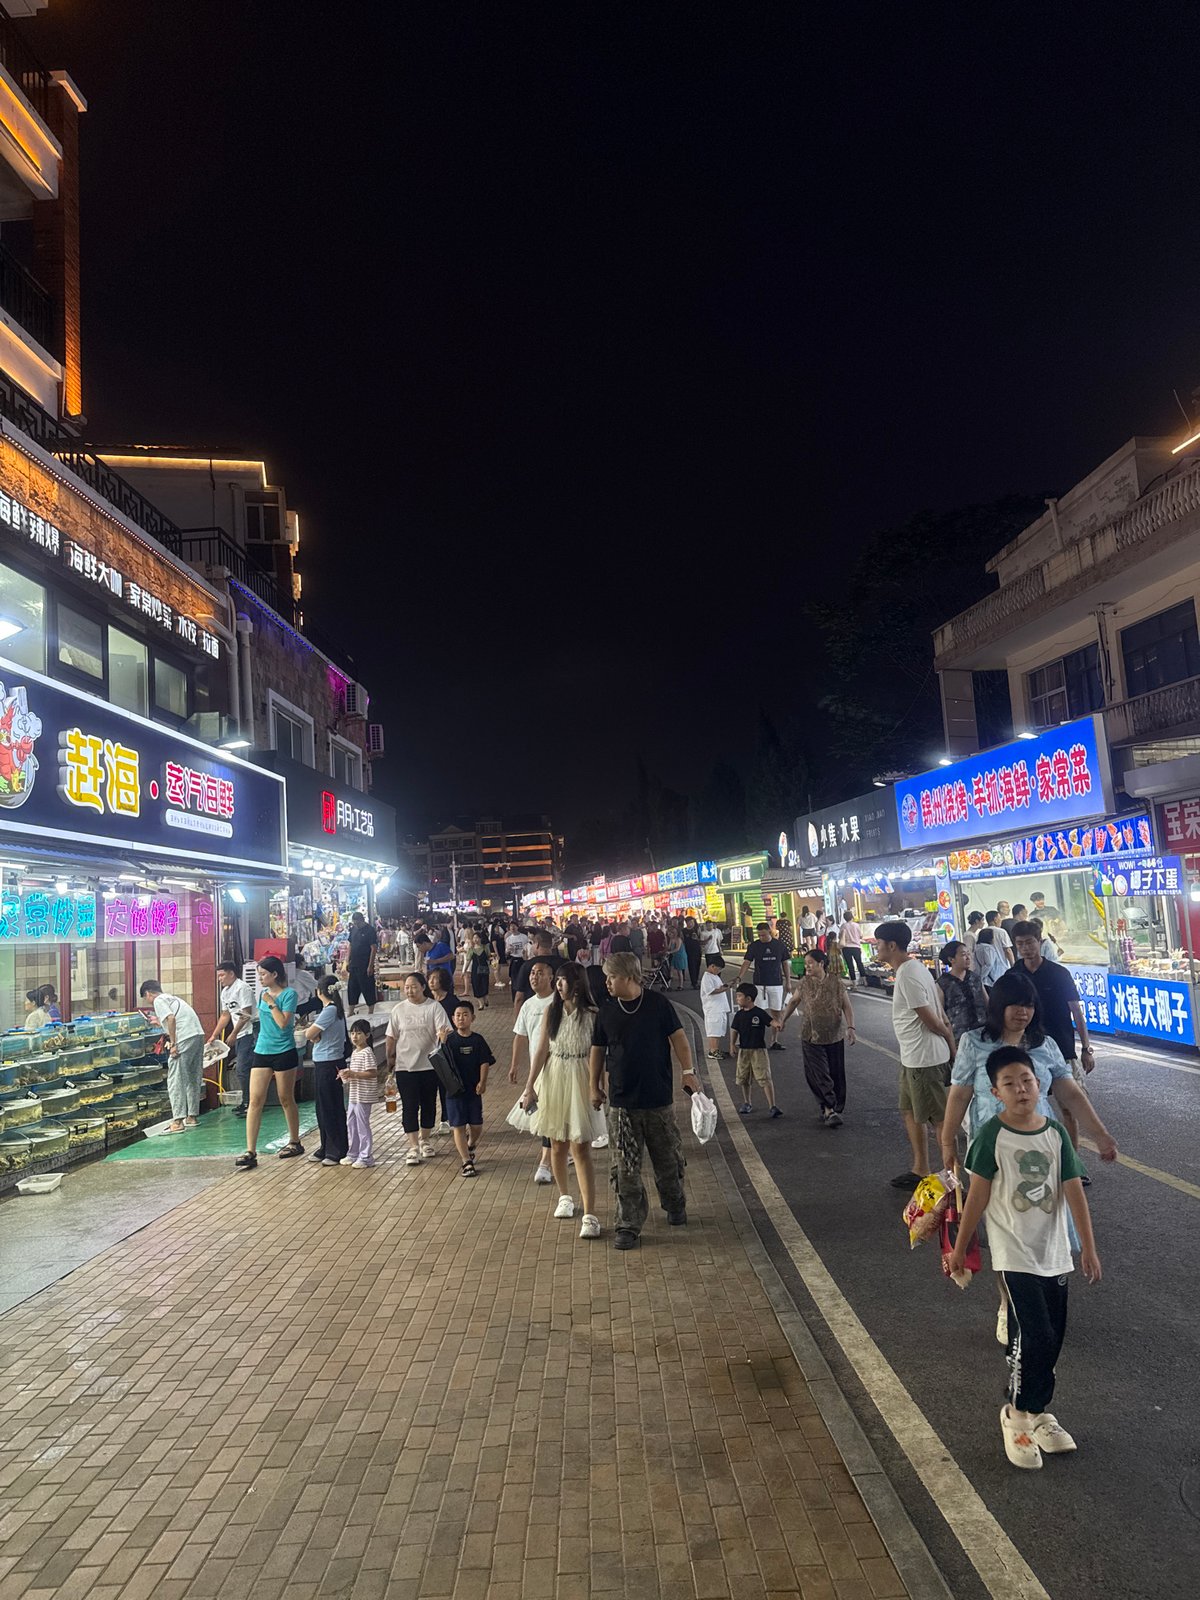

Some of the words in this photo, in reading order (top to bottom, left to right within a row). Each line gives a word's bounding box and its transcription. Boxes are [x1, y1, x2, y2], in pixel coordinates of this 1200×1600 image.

[129, 582, 172, 631] 家常炒菜
[177, 615, 196, 646] 水饺
[202, 630, 219, 659] 拉面
[64, 728, 140, 818] 赶海
[166, 760, 235, 819] 蒸汽海鲜
[1118, 860, 1136, 871] WOW!
[1130, 868, 1178, 890] 椰子下蛋
[0, 890, 96, 939] 家常炒菜
[1112, 983, 1188, 1035] 冰镇大椰子
